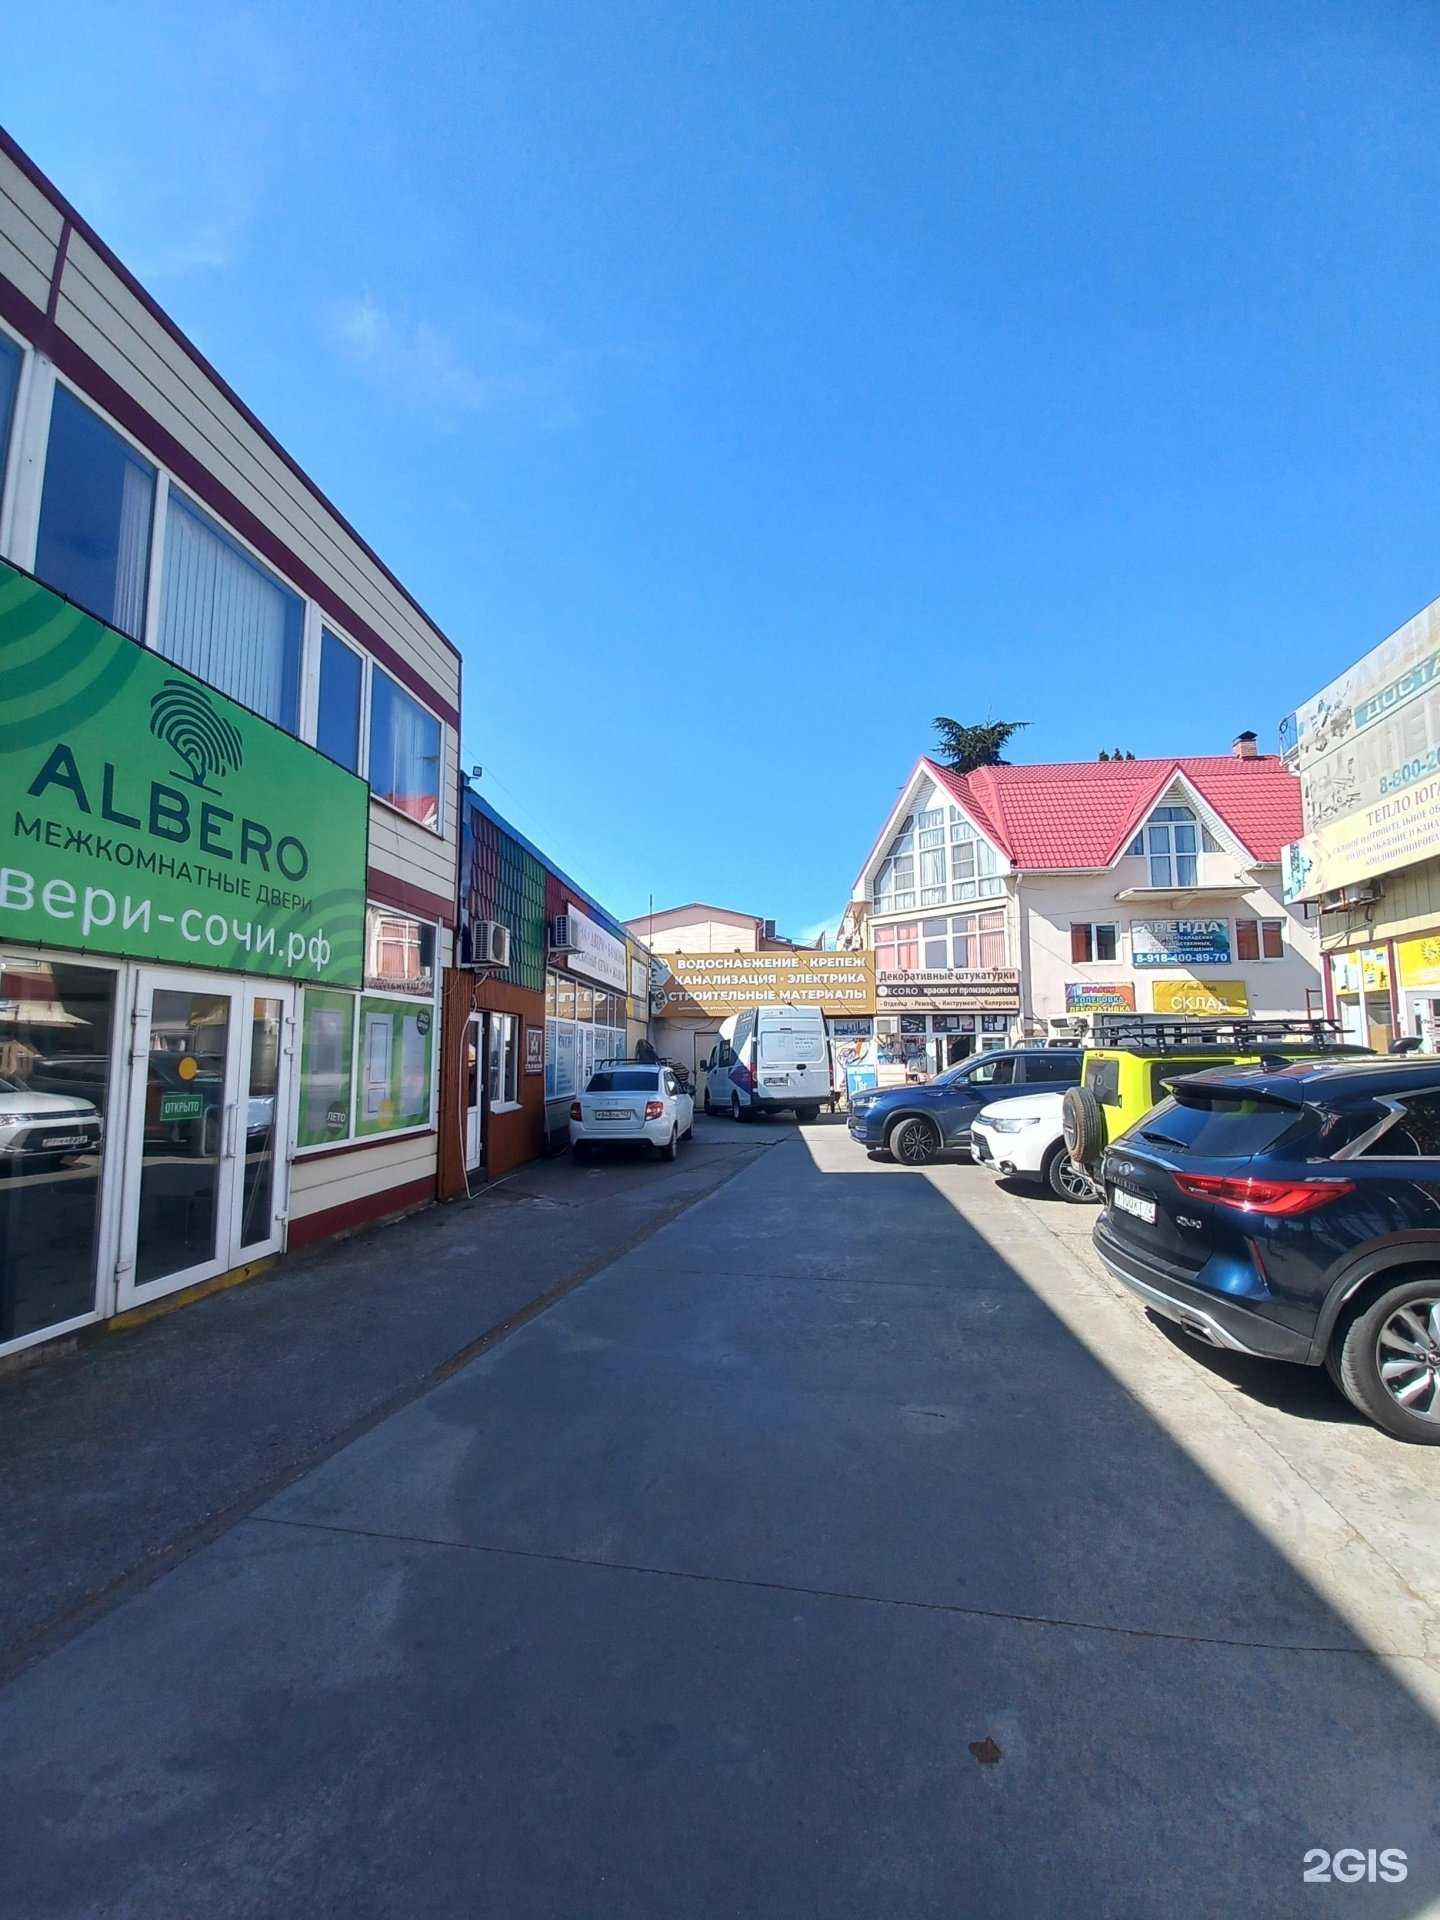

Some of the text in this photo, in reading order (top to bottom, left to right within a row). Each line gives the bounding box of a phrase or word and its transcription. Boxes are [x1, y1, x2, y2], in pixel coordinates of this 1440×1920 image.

[27, 743, 309, 882] ALBERO
[1366, 796, 1411, 826] ТЕПЛО
[13, 810, 314, 915] МЕЖКОМНАТНЫЕ ДВЕРИ
[0, 867, 331, 973] вери-сочи.рф
[1143, 921, 1221, 934] АРЕНДА
[677, 957, 866, 970] ВОДОСНАБЖЕНИЕ КРЕПЕЖ
[674, 973, 866, 987] КАНАЛИЗАЦИЯ ЭЛЕКТРИКА
[879, 970, 1016, 983] Декоративные штукатурки
[667, 989, 867, 1002] СТРОИТЕЛЬНЫЕ МАТЕРИАЛЫ
[165, 1101, 200, 1114] ОТКРЫТО
[327, 1111, 346, 1122] ЛЕТО
